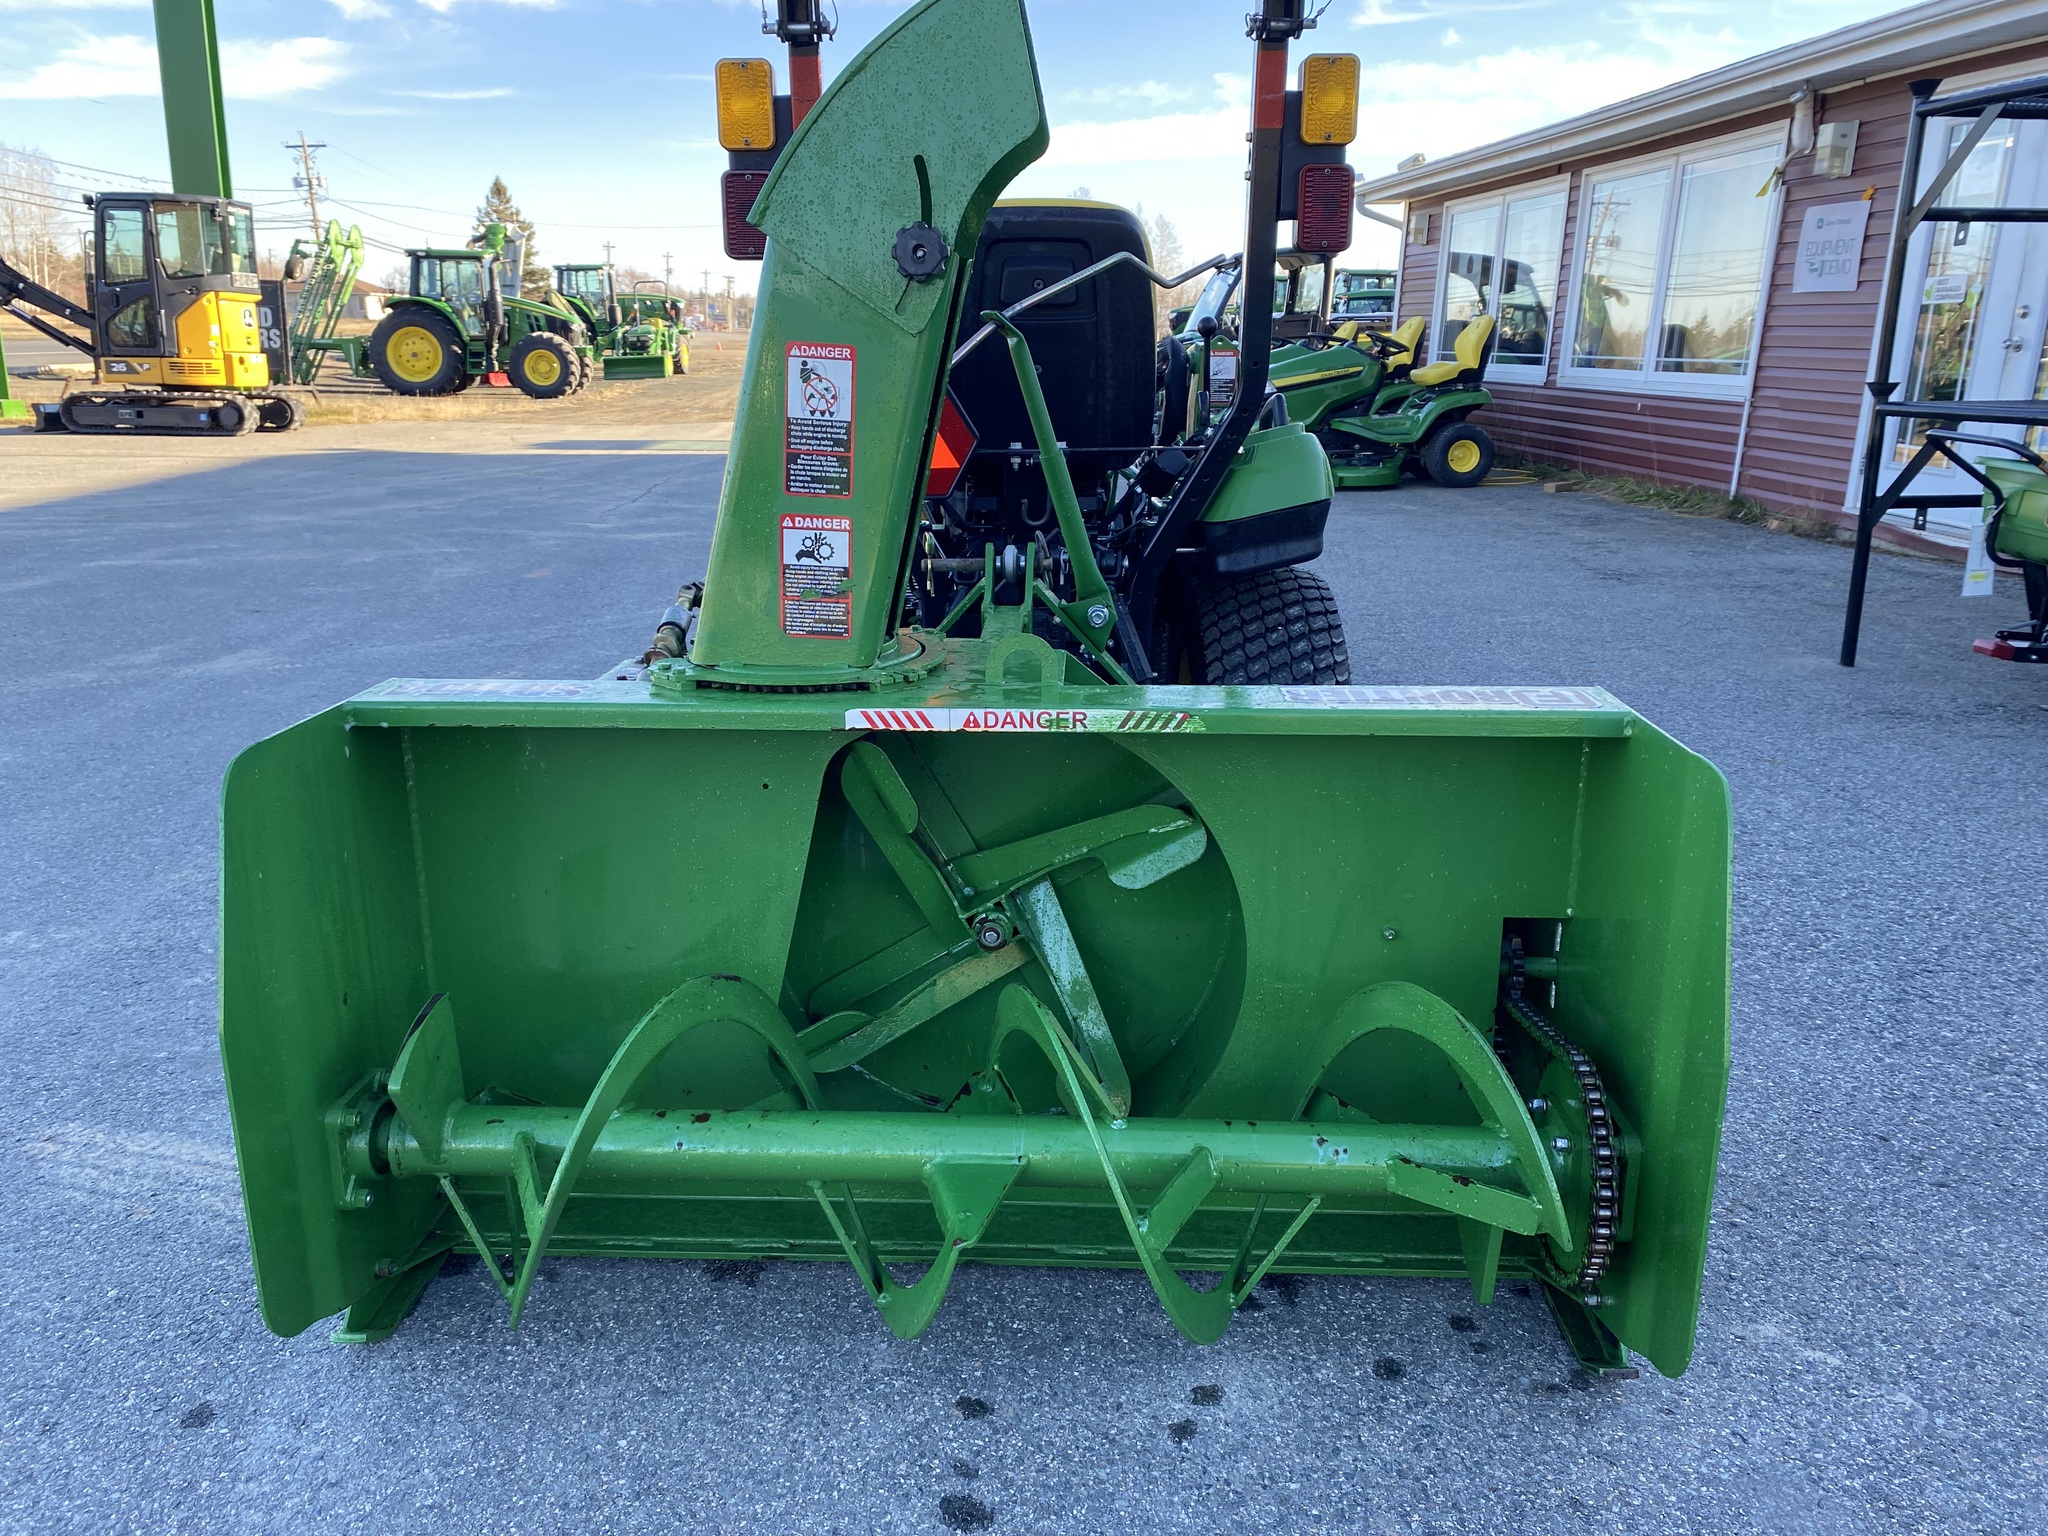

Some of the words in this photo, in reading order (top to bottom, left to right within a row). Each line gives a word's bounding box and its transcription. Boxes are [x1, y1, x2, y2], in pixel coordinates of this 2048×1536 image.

[1806, 239, 1857, 257] EQUIPMENT
[1824, 259, 1851, 275] DEMO
[260, 308, 272, 327] D
[260, 328, 281, 348] RS
[800, 346, 851, 359] DANGER
[110, 363, 127, 371] 26
[795, 517, 850, 529] DANGER
[1285, 687, 1603, 708] FRONTIER
[983, 711, 1088, 729] DANGER
